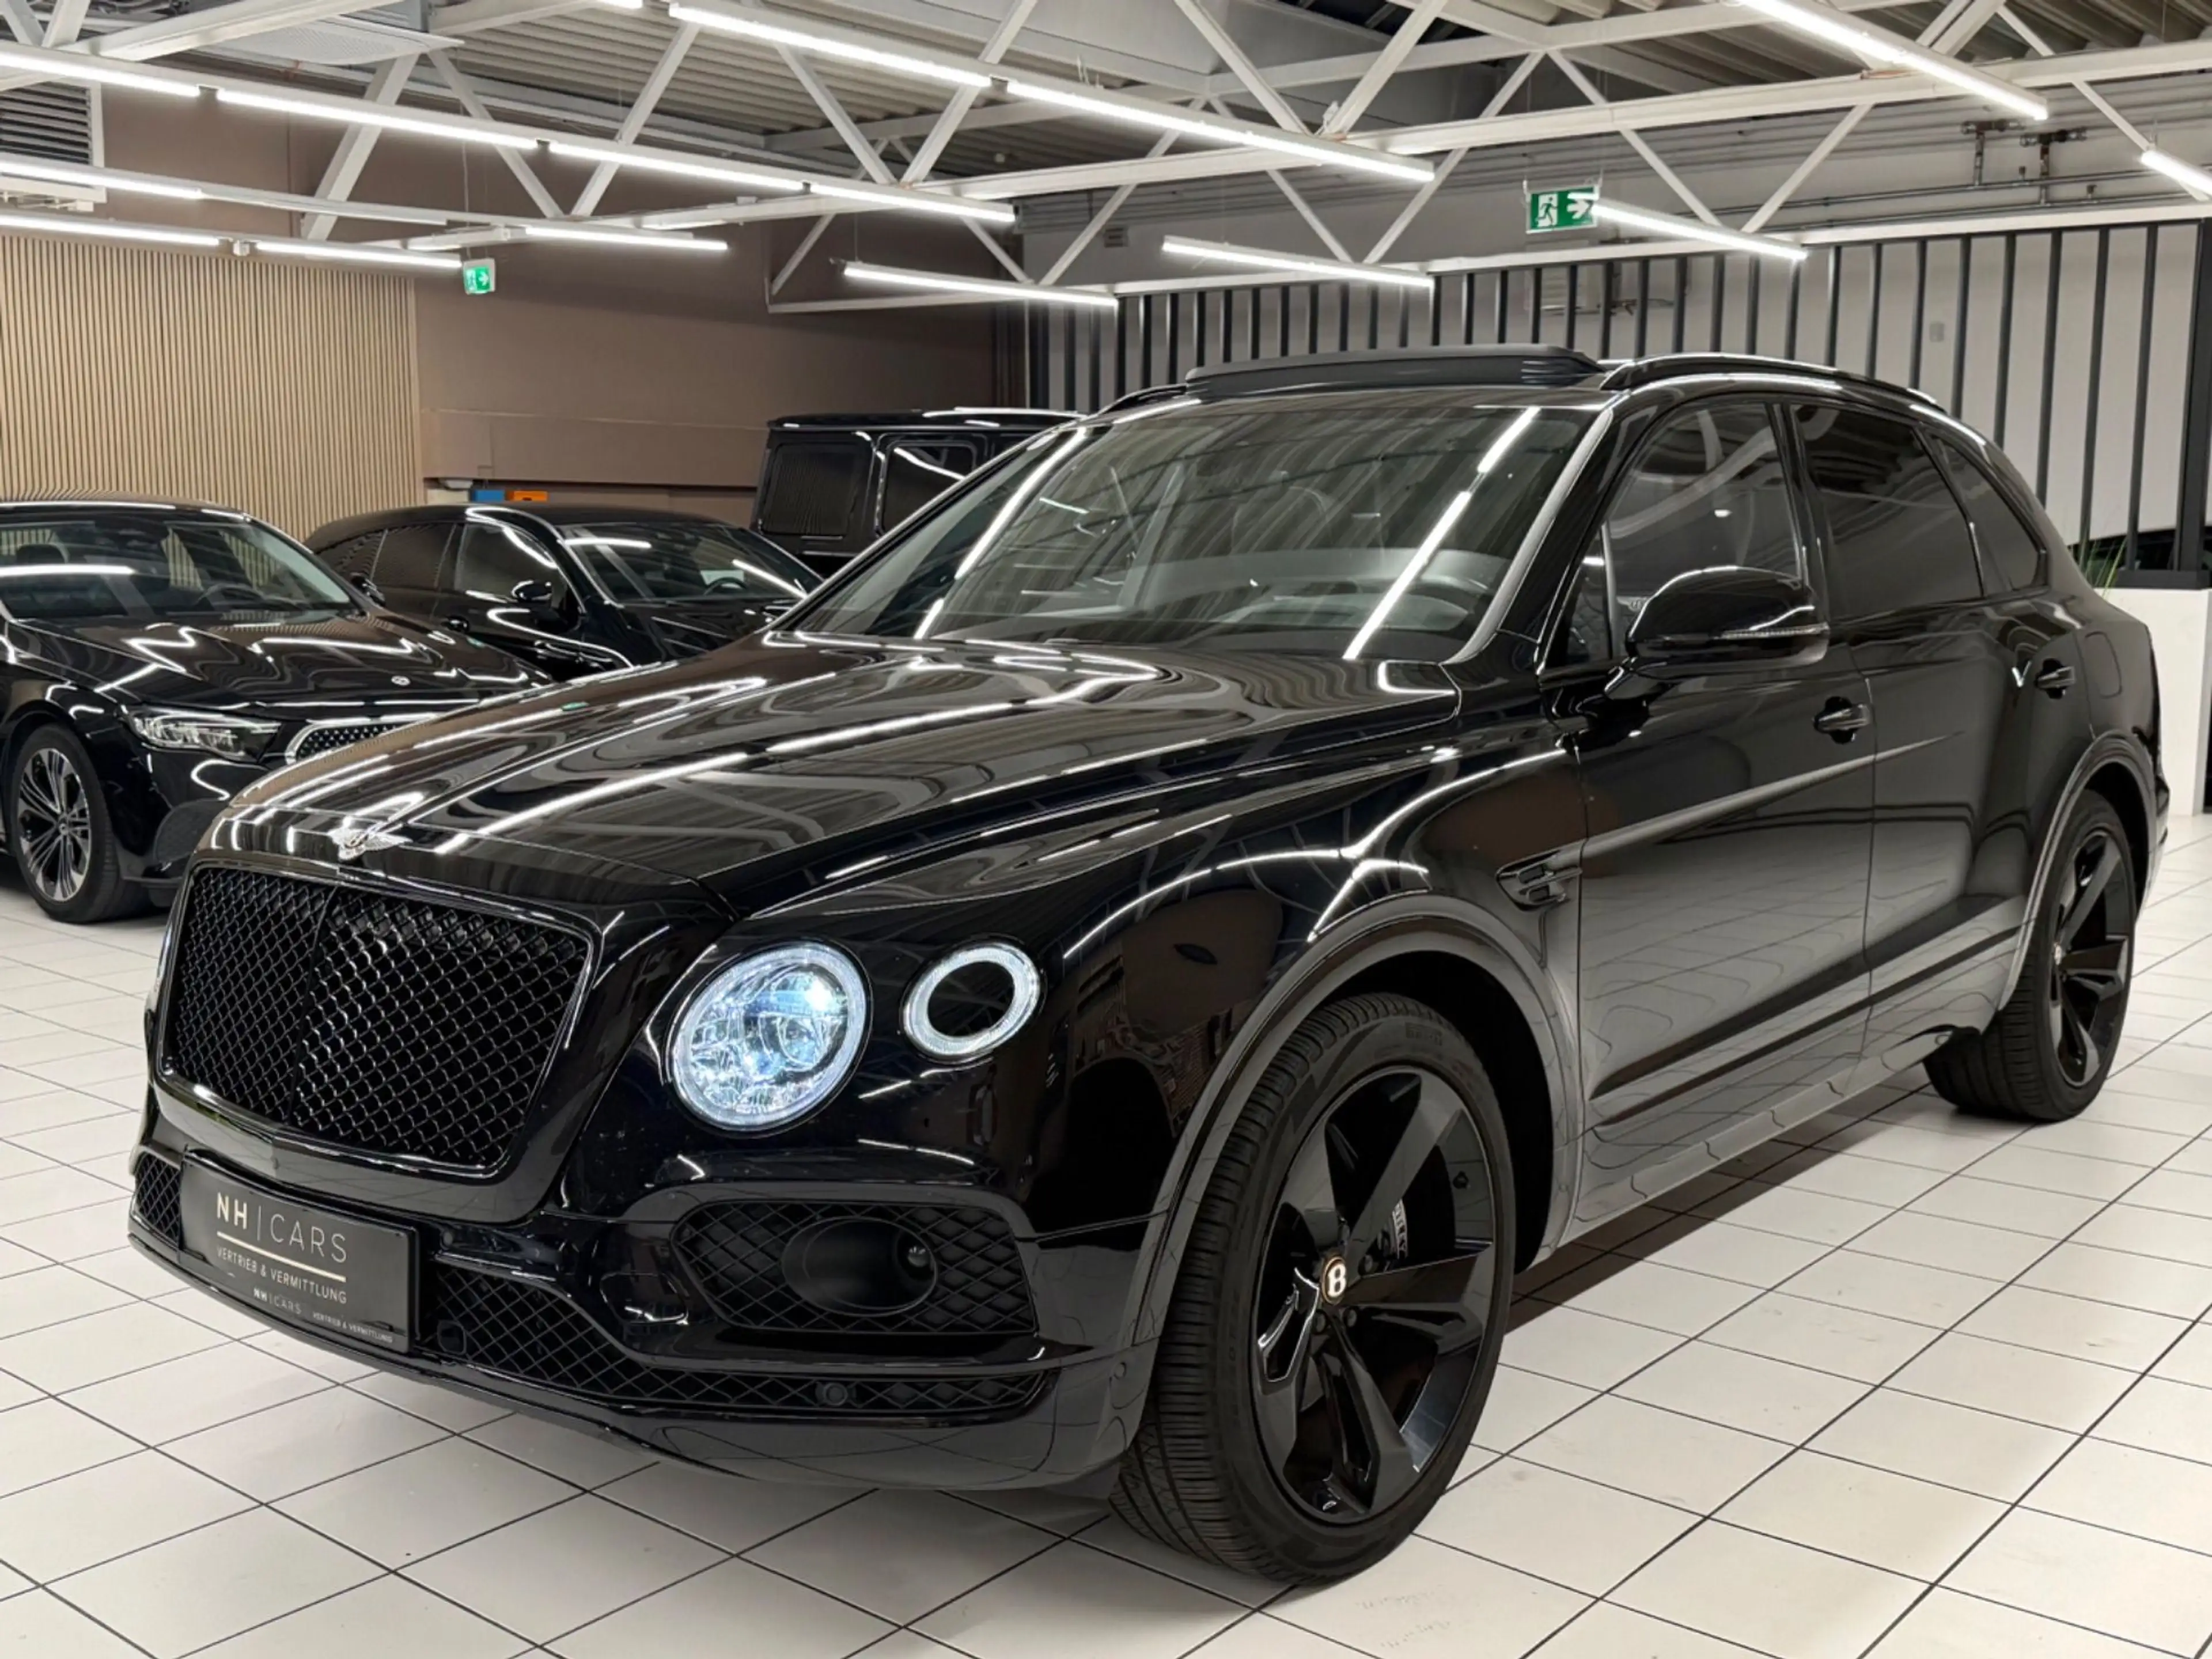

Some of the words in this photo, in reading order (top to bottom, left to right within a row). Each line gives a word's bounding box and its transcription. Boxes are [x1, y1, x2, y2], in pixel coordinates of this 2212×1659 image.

[217, 1192, 247, 1229] NH
[270, 1213, 347, 1263] CARS
[216, 1246, 257, 1273] VERTRIEB
[260, 1264, 267, 1278] &
[270, 1268, 347, 1304] VERMITTLUNG
[274, 1294, 302, 1314] CARS
